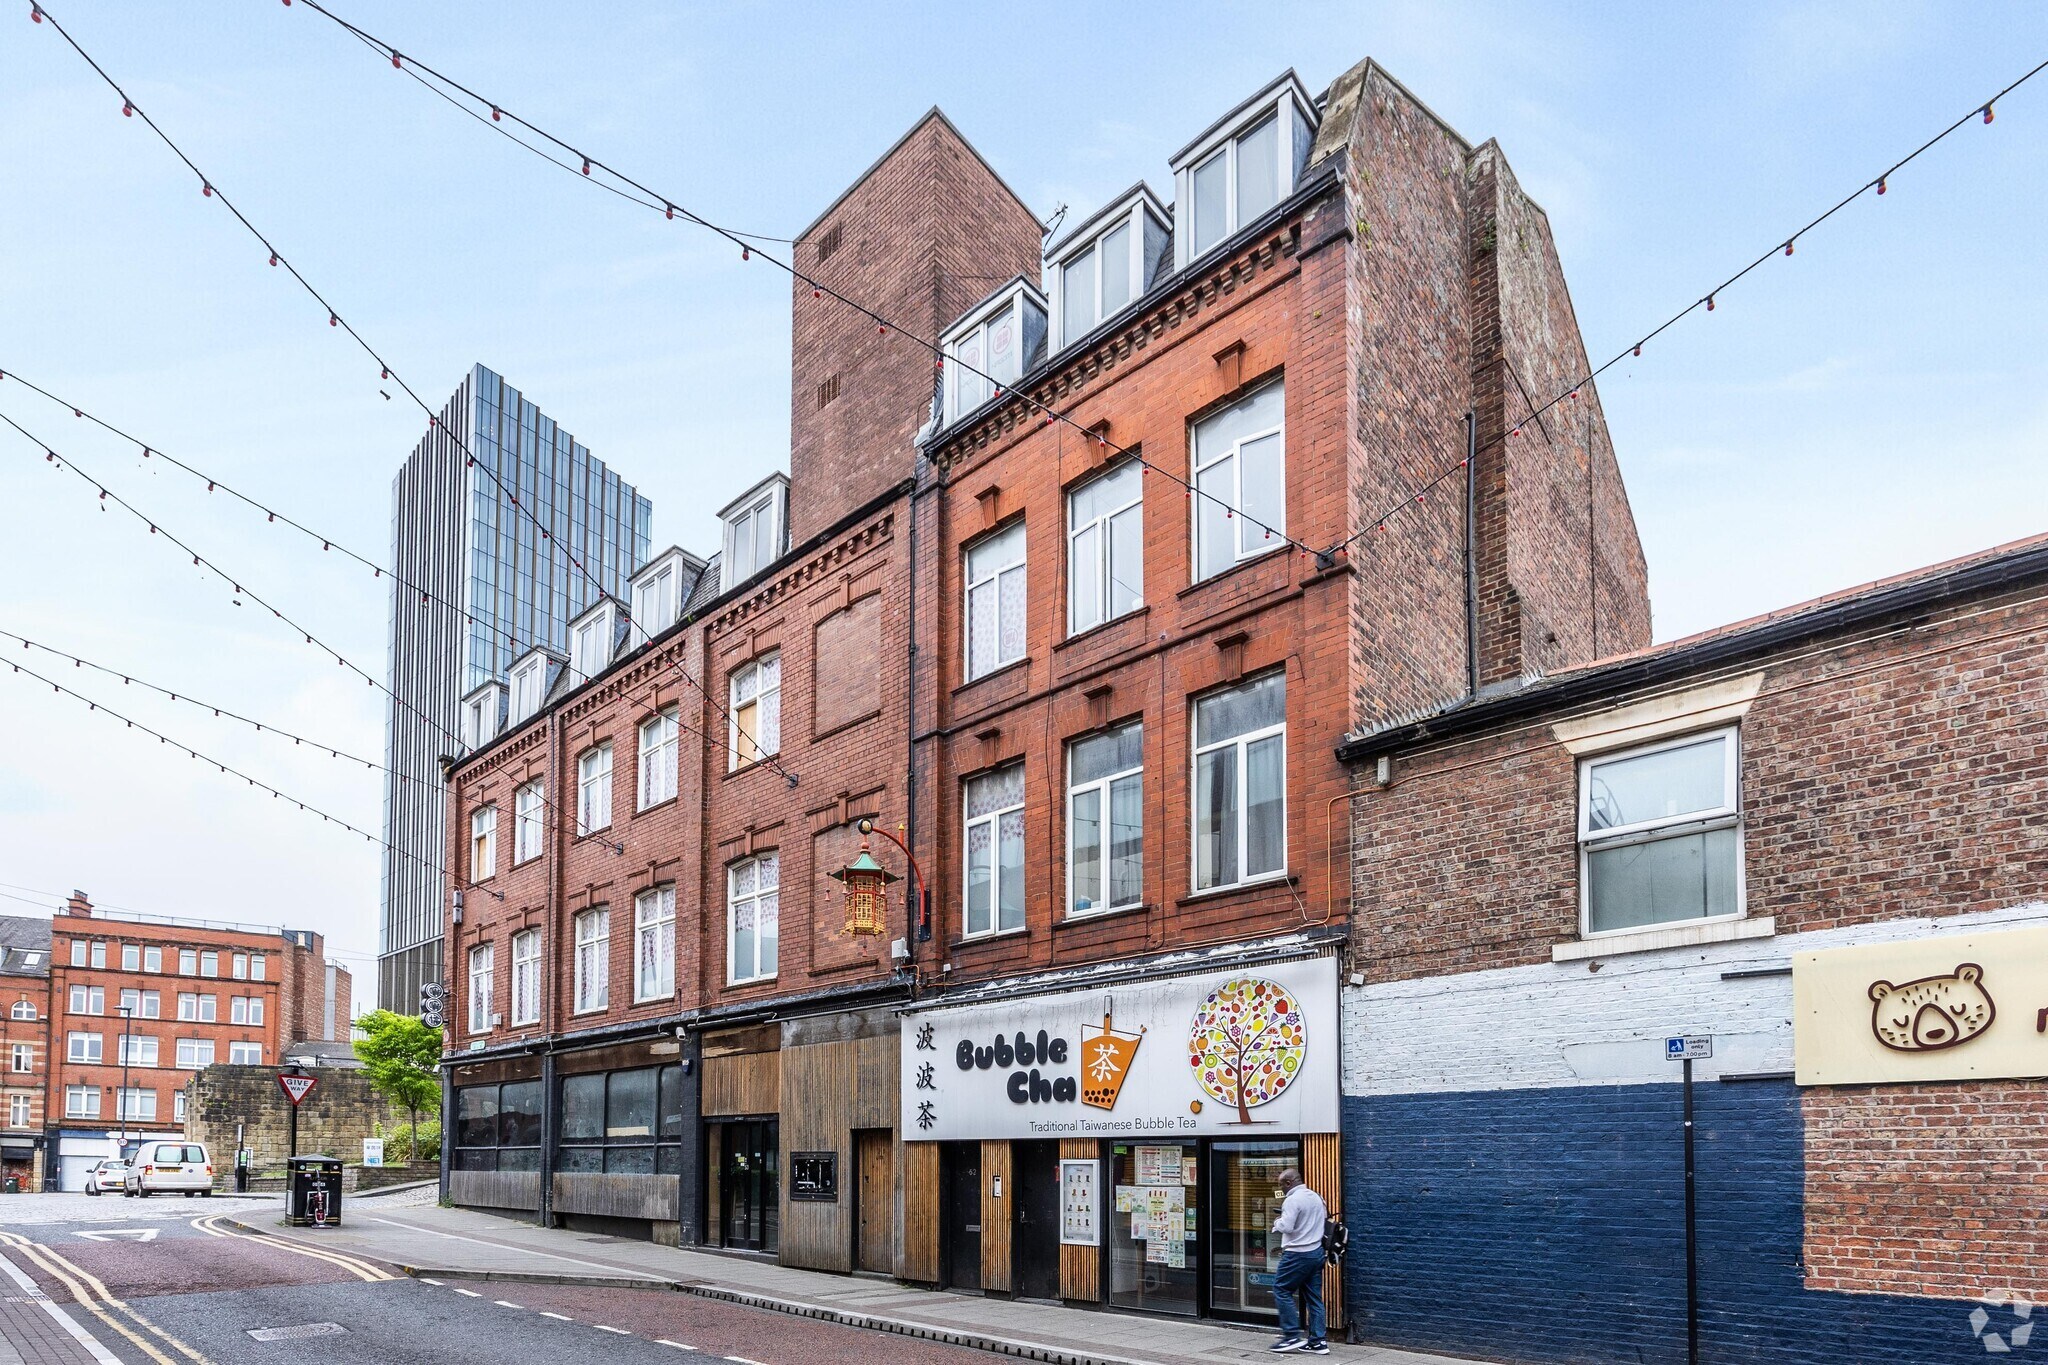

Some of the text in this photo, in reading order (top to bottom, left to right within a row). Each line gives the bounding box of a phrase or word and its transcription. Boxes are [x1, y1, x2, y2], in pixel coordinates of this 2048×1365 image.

[956, 1029, 1068, 1071] Bubble
[1087, 1043, 1122, 1083] 茶
[915, 1021, 937, 1131] 波波茶
[1006, 1068, 1077, 1104] Cha
[1029, 1116, 1197, 1132] Traditional Taiwanese Bubble Tea
[968, 1168, 976, 1176] 62
